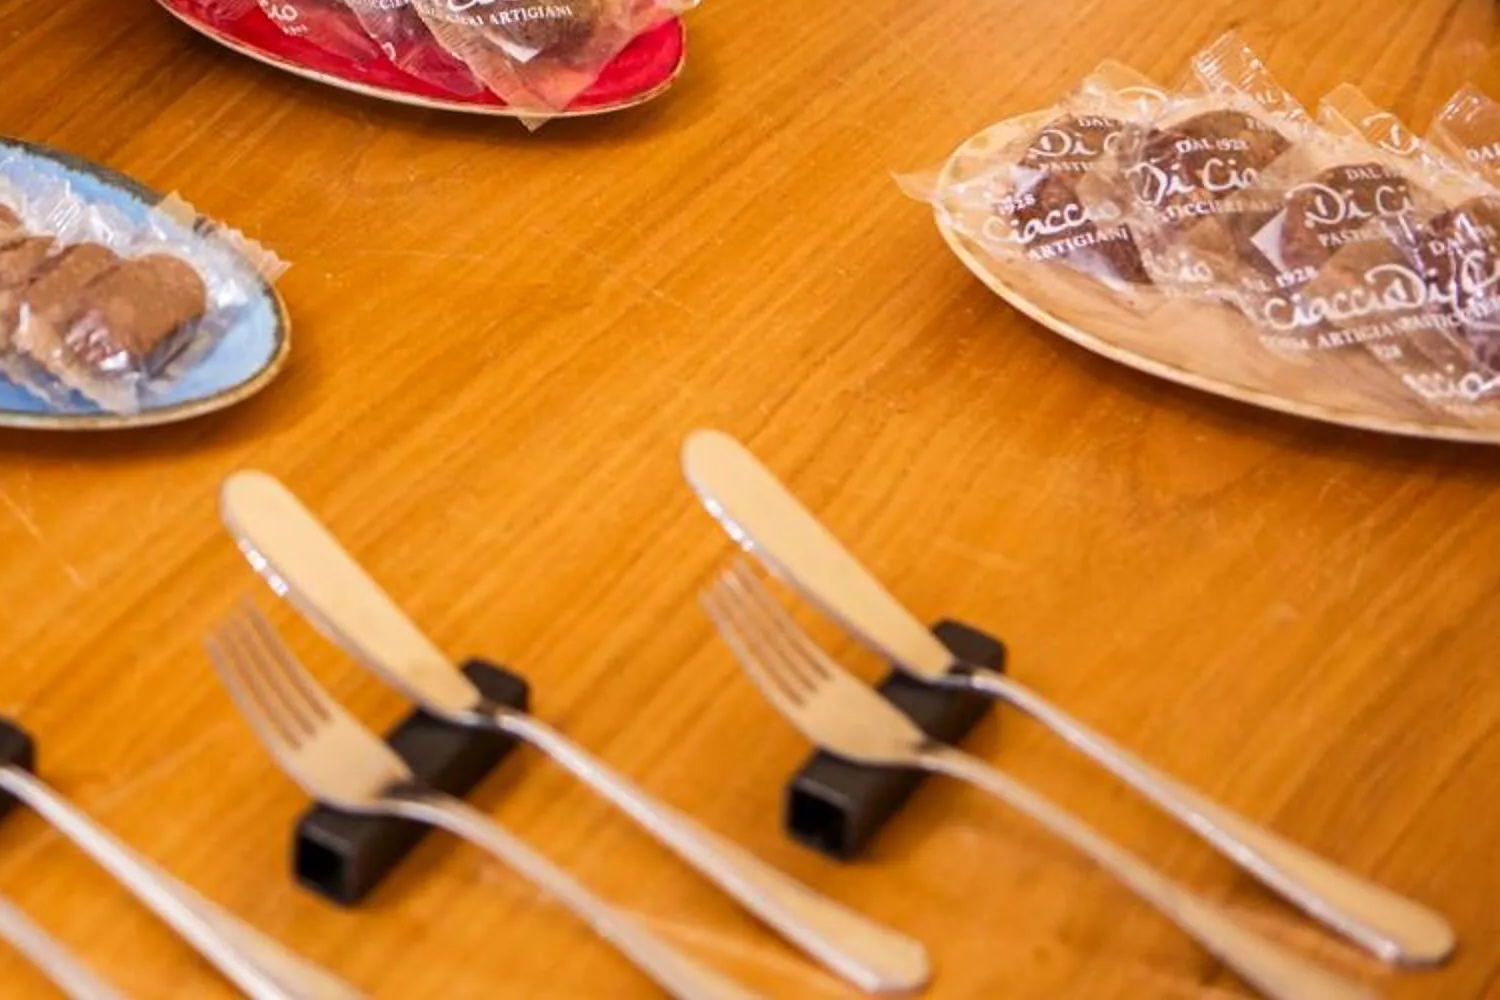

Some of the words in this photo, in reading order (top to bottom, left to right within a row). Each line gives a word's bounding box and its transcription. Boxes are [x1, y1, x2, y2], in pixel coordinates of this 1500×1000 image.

[489, 4, 574, 26] ARTIGIANI
[1028, 129, 1097, 158] Di
[1285, 183, 1372, 228] Di
[1027, 226, 1127, 261] ARTIGIANI
[1275, 266, 1319, 289] 1928
[1316, 324, 1395, 349] ARTIGIA
